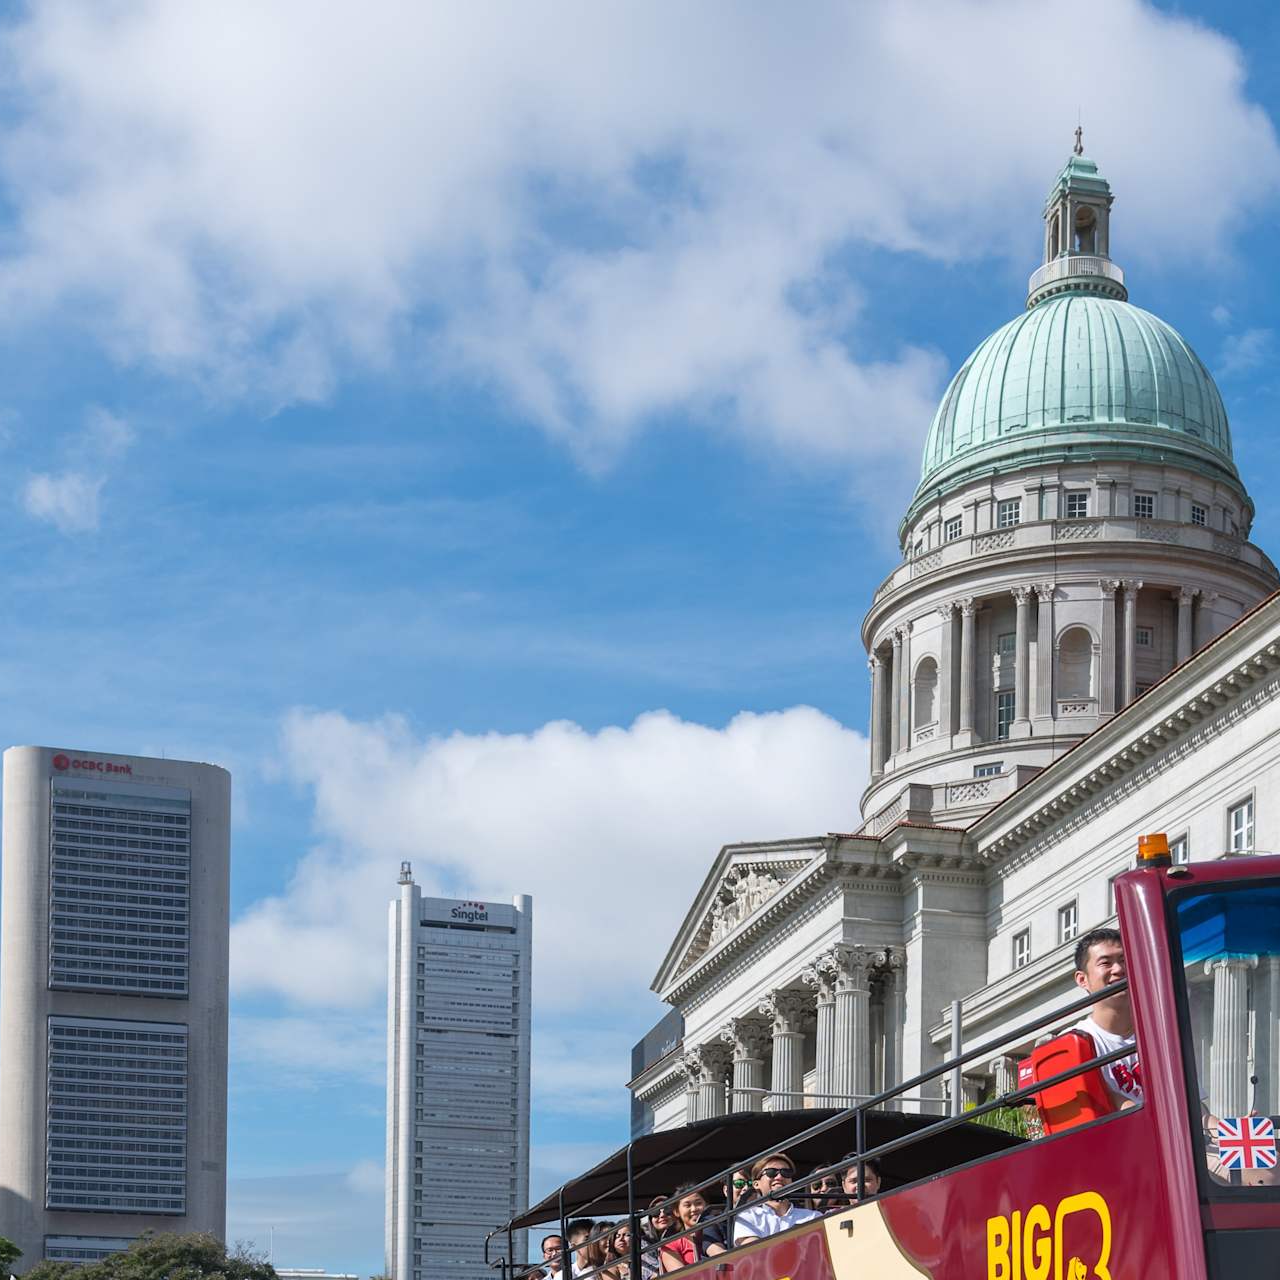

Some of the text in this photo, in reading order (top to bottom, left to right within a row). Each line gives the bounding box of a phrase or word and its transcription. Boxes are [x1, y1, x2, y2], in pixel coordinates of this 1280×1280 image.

[71, 760, 133, 776] OCBC Bank
[451, 908, 489, 922] Singtel
